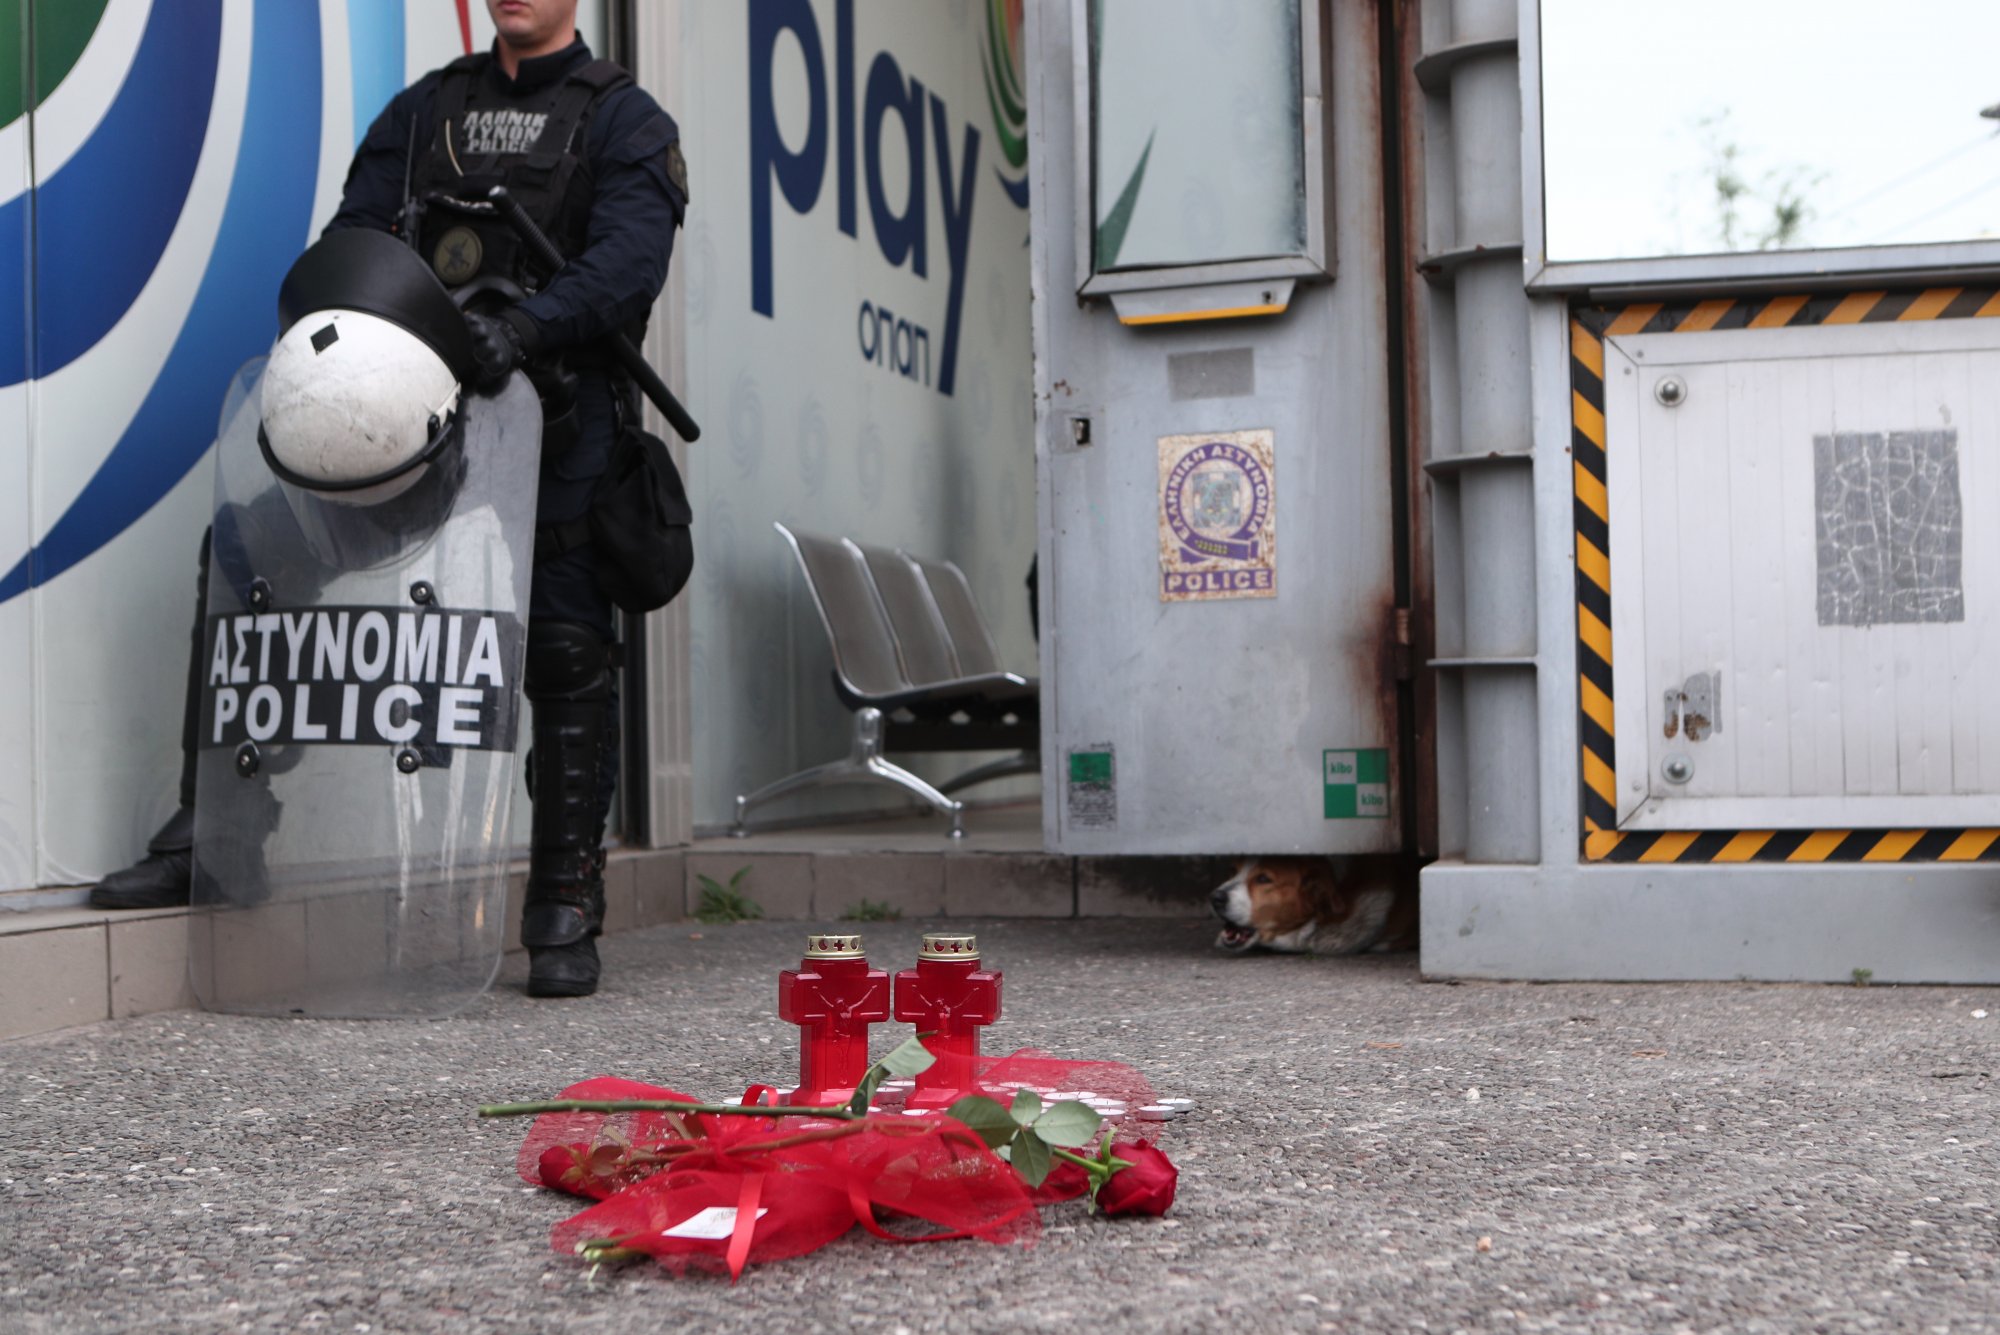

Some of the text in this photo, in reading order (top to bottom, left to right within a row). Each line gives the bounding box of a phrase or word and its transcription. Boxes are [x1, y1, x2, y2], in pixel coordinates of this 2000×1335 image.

[748, 0, 981, 397] play
[1167, 444, 1268, 540] ΕΛΛΗΝΙΚΗ ΑΣΤΥΝΟΜΙΑ
[1168, 570, 1270, 592] POLICE
[209, 611, 504, 687] ΑΣΤΥΝΟΜΙΑ
[213, 684, 484, 745] POLICE
